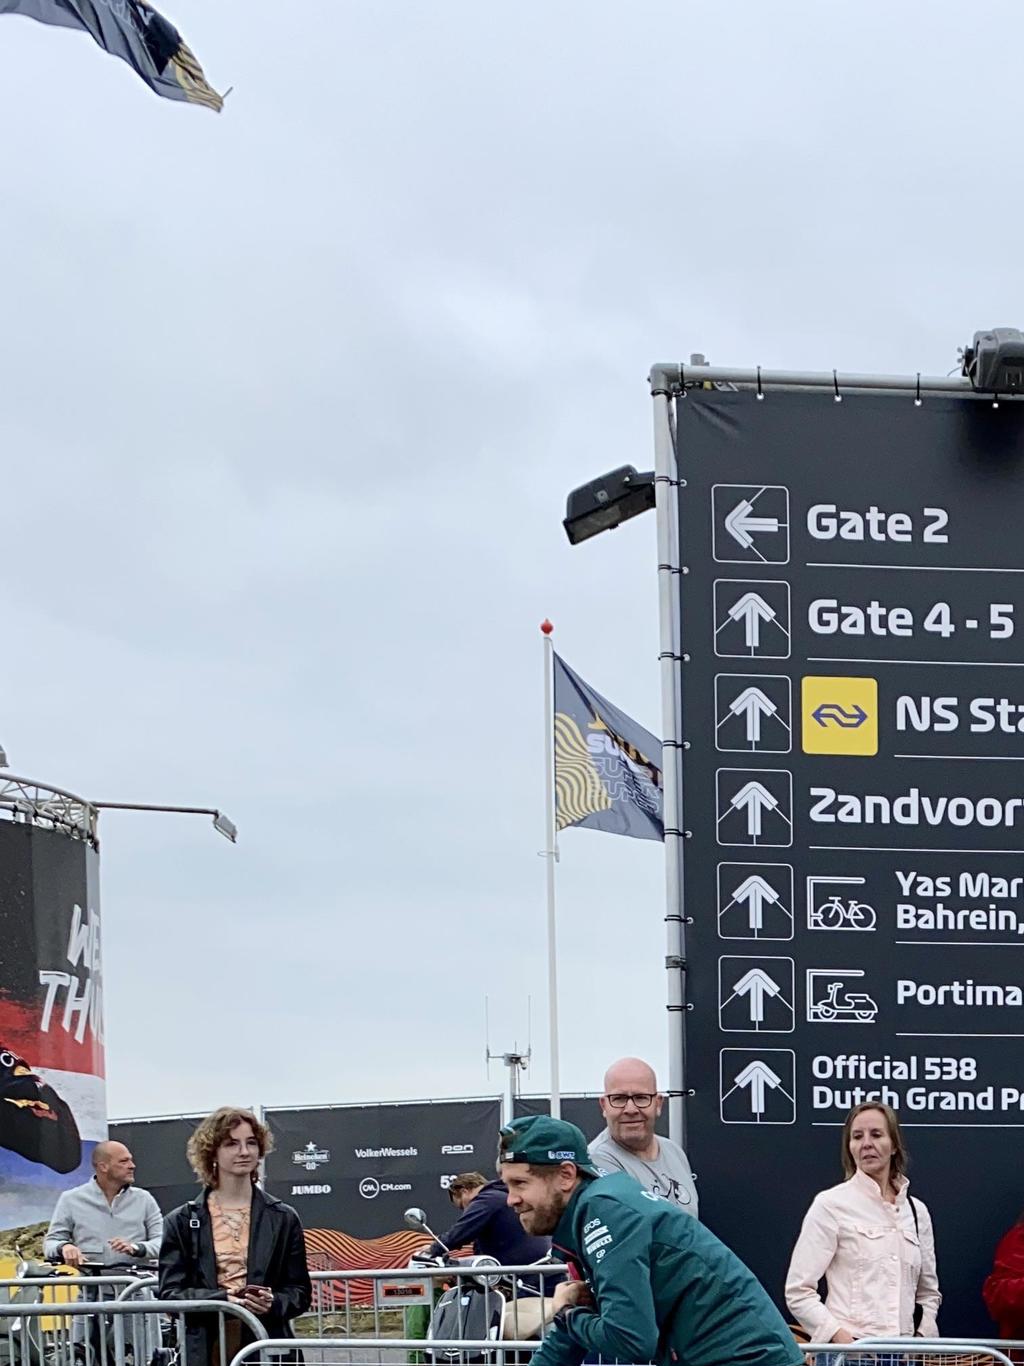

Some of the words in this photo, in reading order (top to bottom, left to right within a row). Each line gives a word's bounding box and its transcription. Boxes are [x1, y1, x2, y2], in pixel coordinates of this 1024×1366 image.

[807, 504, 913, 542] Gate
[923, 507, 949, 543] 2
[808, 598, 914, 637] Gate
[923, 602, 954, 638] 4
[965, 619, 978, 629] -
[990, 603, 1014, 639] 5
[896, 695, 959, 732] NS
[895, 870, 951, 897] Yas
[812, 1054, 917, 1080] Official
[924, 1057, 977, 1081] 538
[906, 1086, 994, 1111] Grand
[355, 1147, 418, 1158] VolkerWessels
[291, 1184, 332, 1195] JUMBO
[380, 1183, 412, 1191] CM.com
